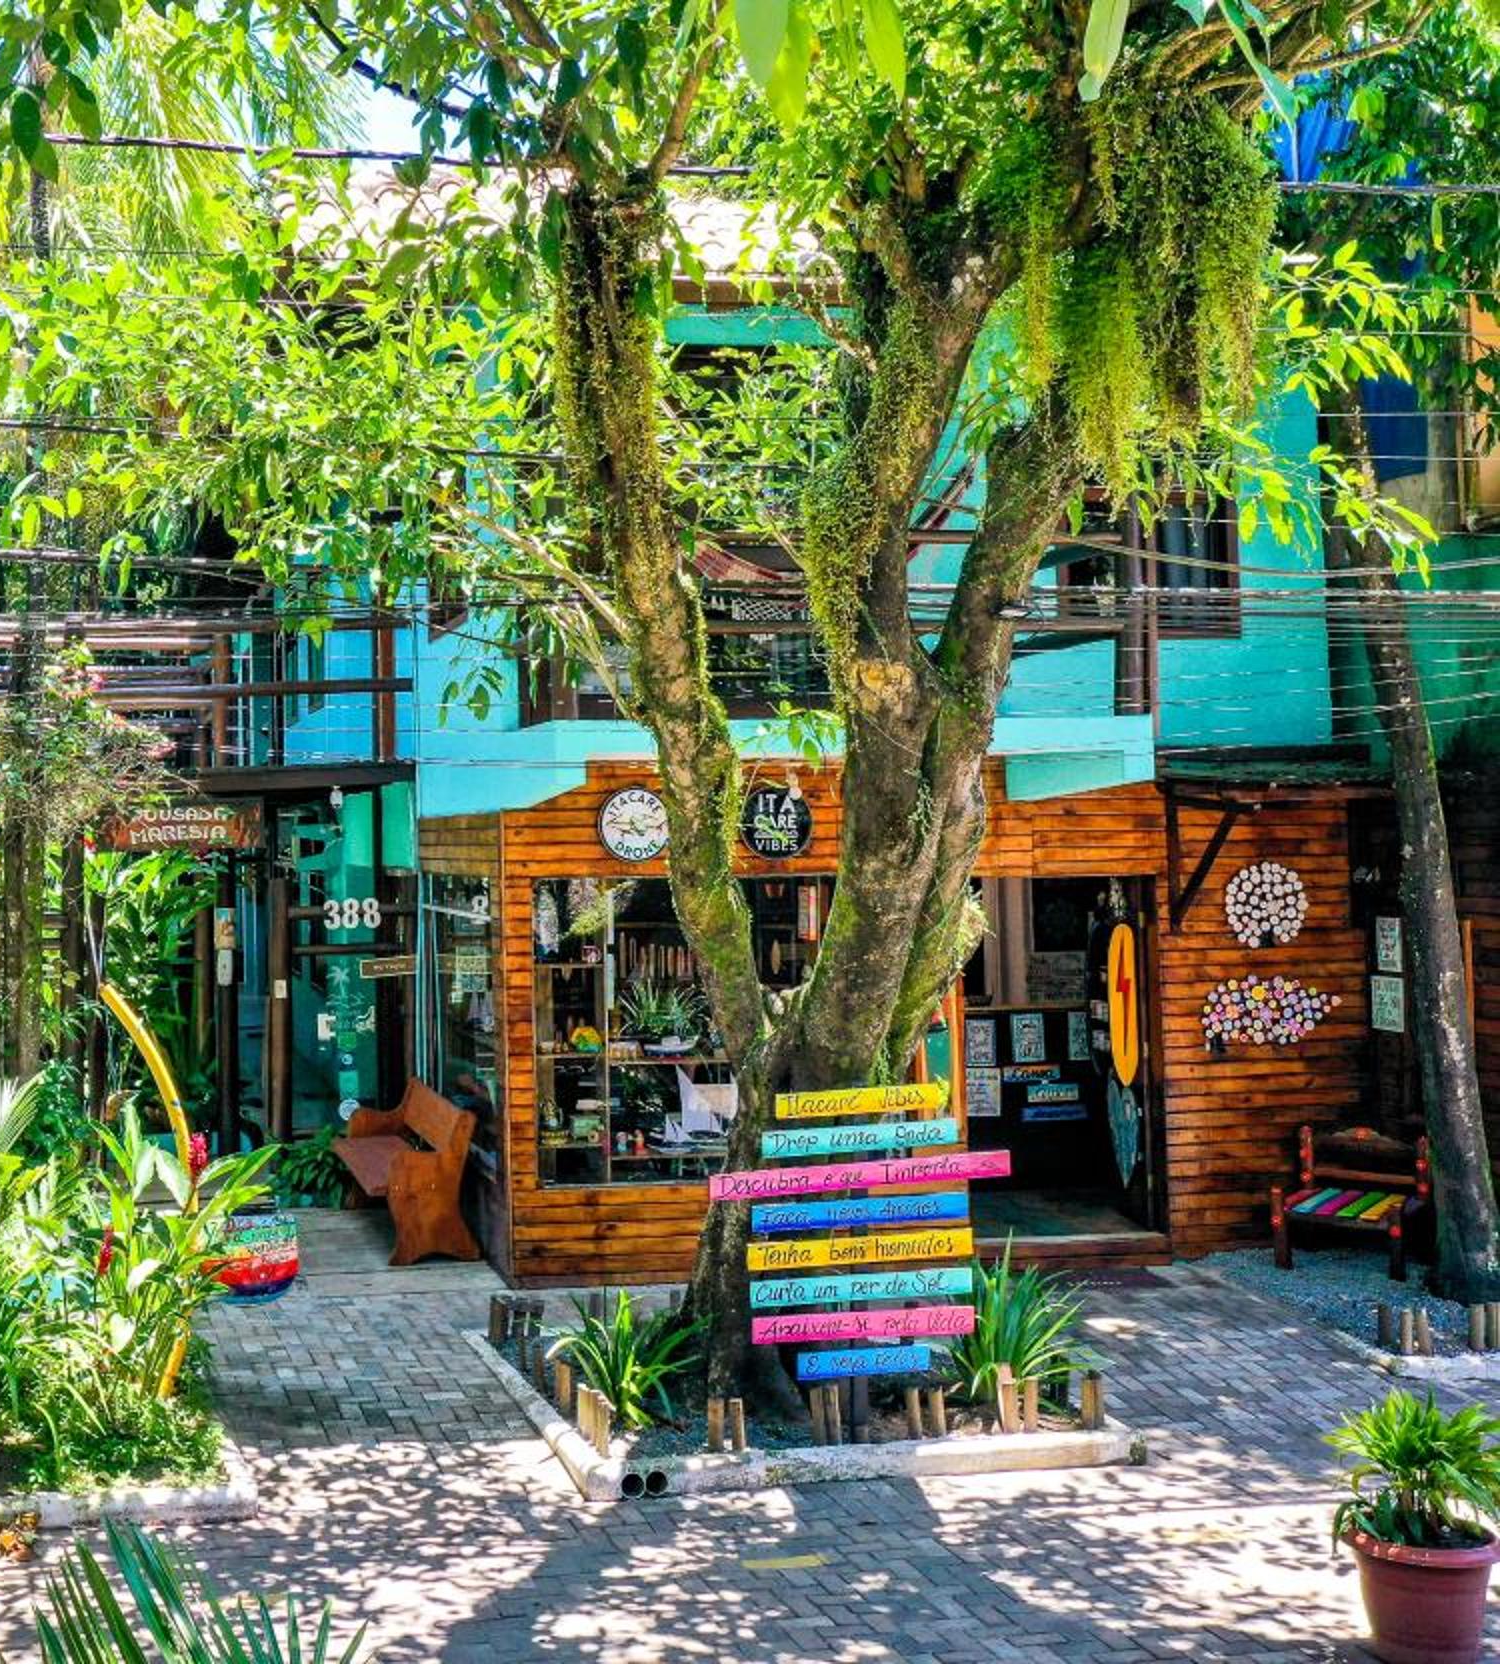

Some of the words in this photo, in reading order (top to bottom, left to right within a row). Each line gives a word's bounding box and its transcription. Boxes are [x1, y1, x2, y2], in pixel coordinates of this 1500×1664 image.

[759, 795, 796, 813] ITA
[753, 814, 797, 829] CARE
[755, 838, 799, 852] VIBES
[323, 897, 382, 930] 388
